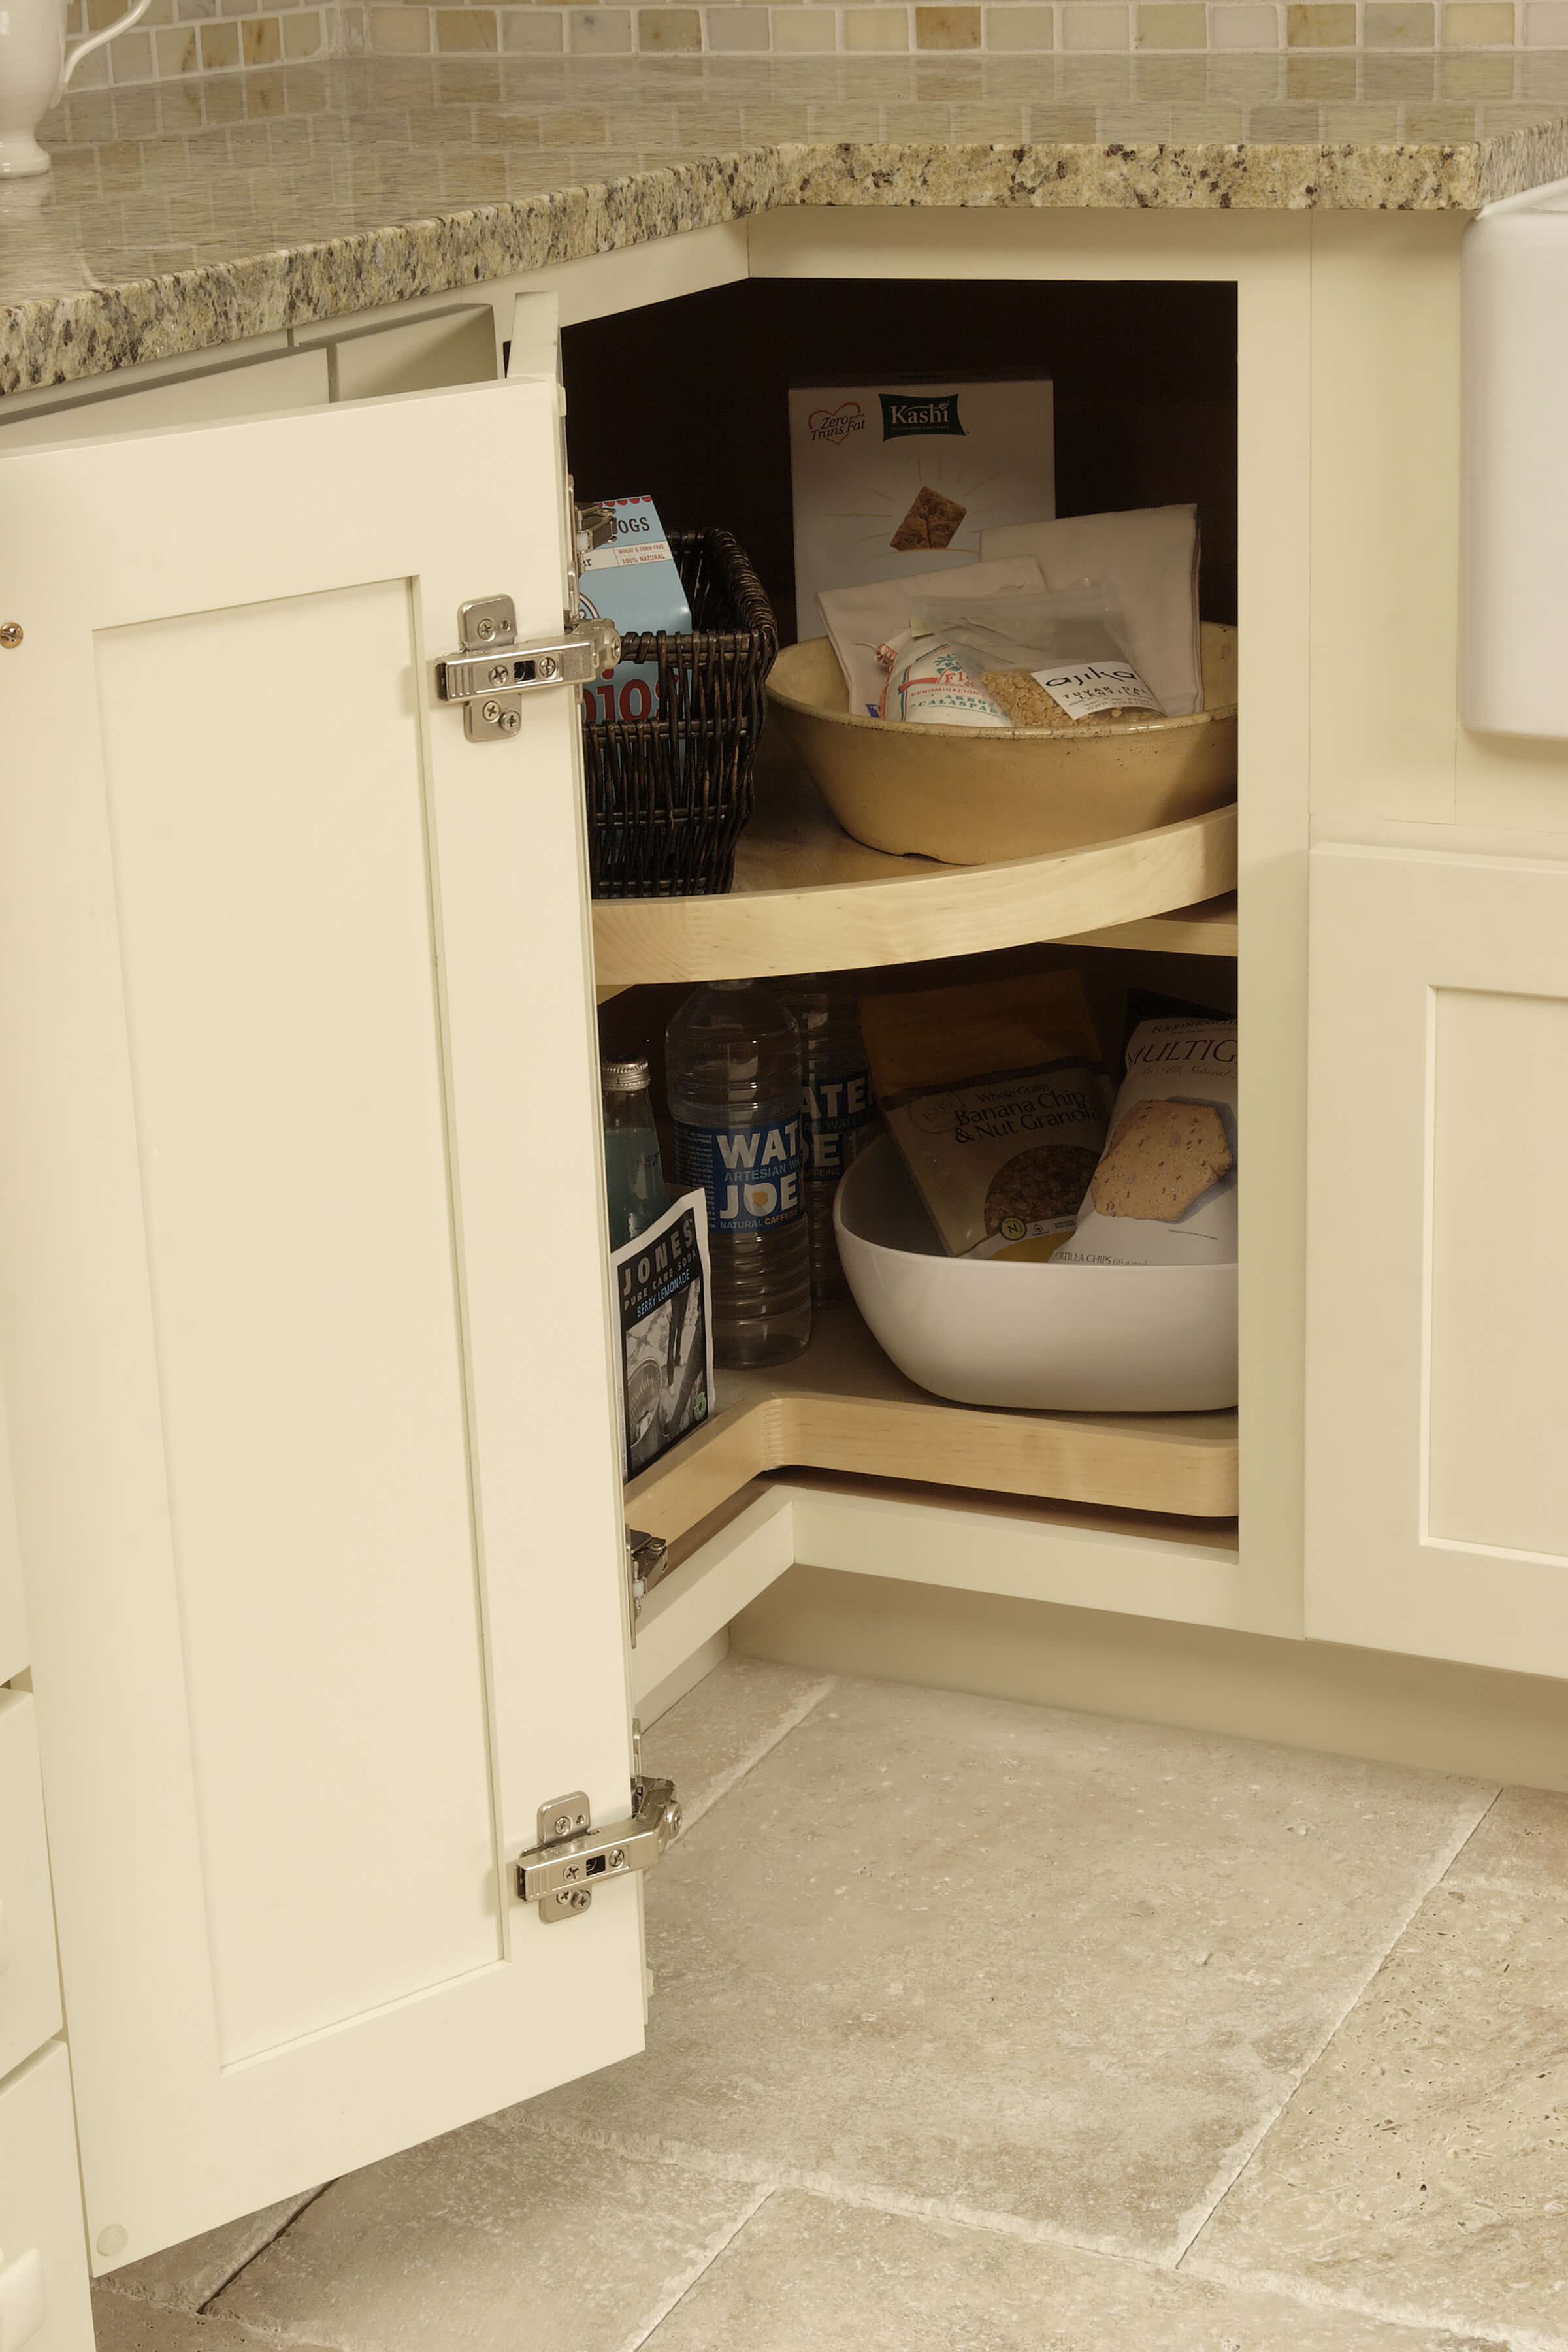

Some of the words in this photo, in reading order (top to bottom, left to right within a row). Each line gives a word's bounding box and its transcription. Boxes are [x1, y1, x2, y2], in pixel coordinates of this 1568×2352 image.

[820, 417, 848, 430] Zero
[889, 403, 951, 425] Kashi
[811, 425, 843, 440] Trans
[847, 417, 866, 433] Fat
[617, 517, 650, 534] OGS
[639, 553, 666, 563] NATURAL
[977, 1090, 1015, 1103] Whole
[1017, 1082, 1049, 1096] Grain
[955, 1099, 1036, 1126] Banana
[1037, 1090, 1087, 1109] Chip
[955, 1127, 975, 1143] &
[975, 1120, 1019, 1141] Nut
[1021, 1103, 1100, 1130] Granola
[724, 1164, 787, 1182] ARTESIAN
[719, 1171, 798, 1220] JOE
[720, 1218, 762, 1229] NATURAL
[623, 1217, 694, 1297] JONES
[1086, 1254, 1112, 1266] CHIPS
[624, 1287, 648, 1312] PURE
[653, 1267, 674, 1290] CANE
[678, 1249, 696, 1271] SODA
[636, 1293, 657, 1318] BERRY
[657, 1267, 691, 1303] LEMONADE
